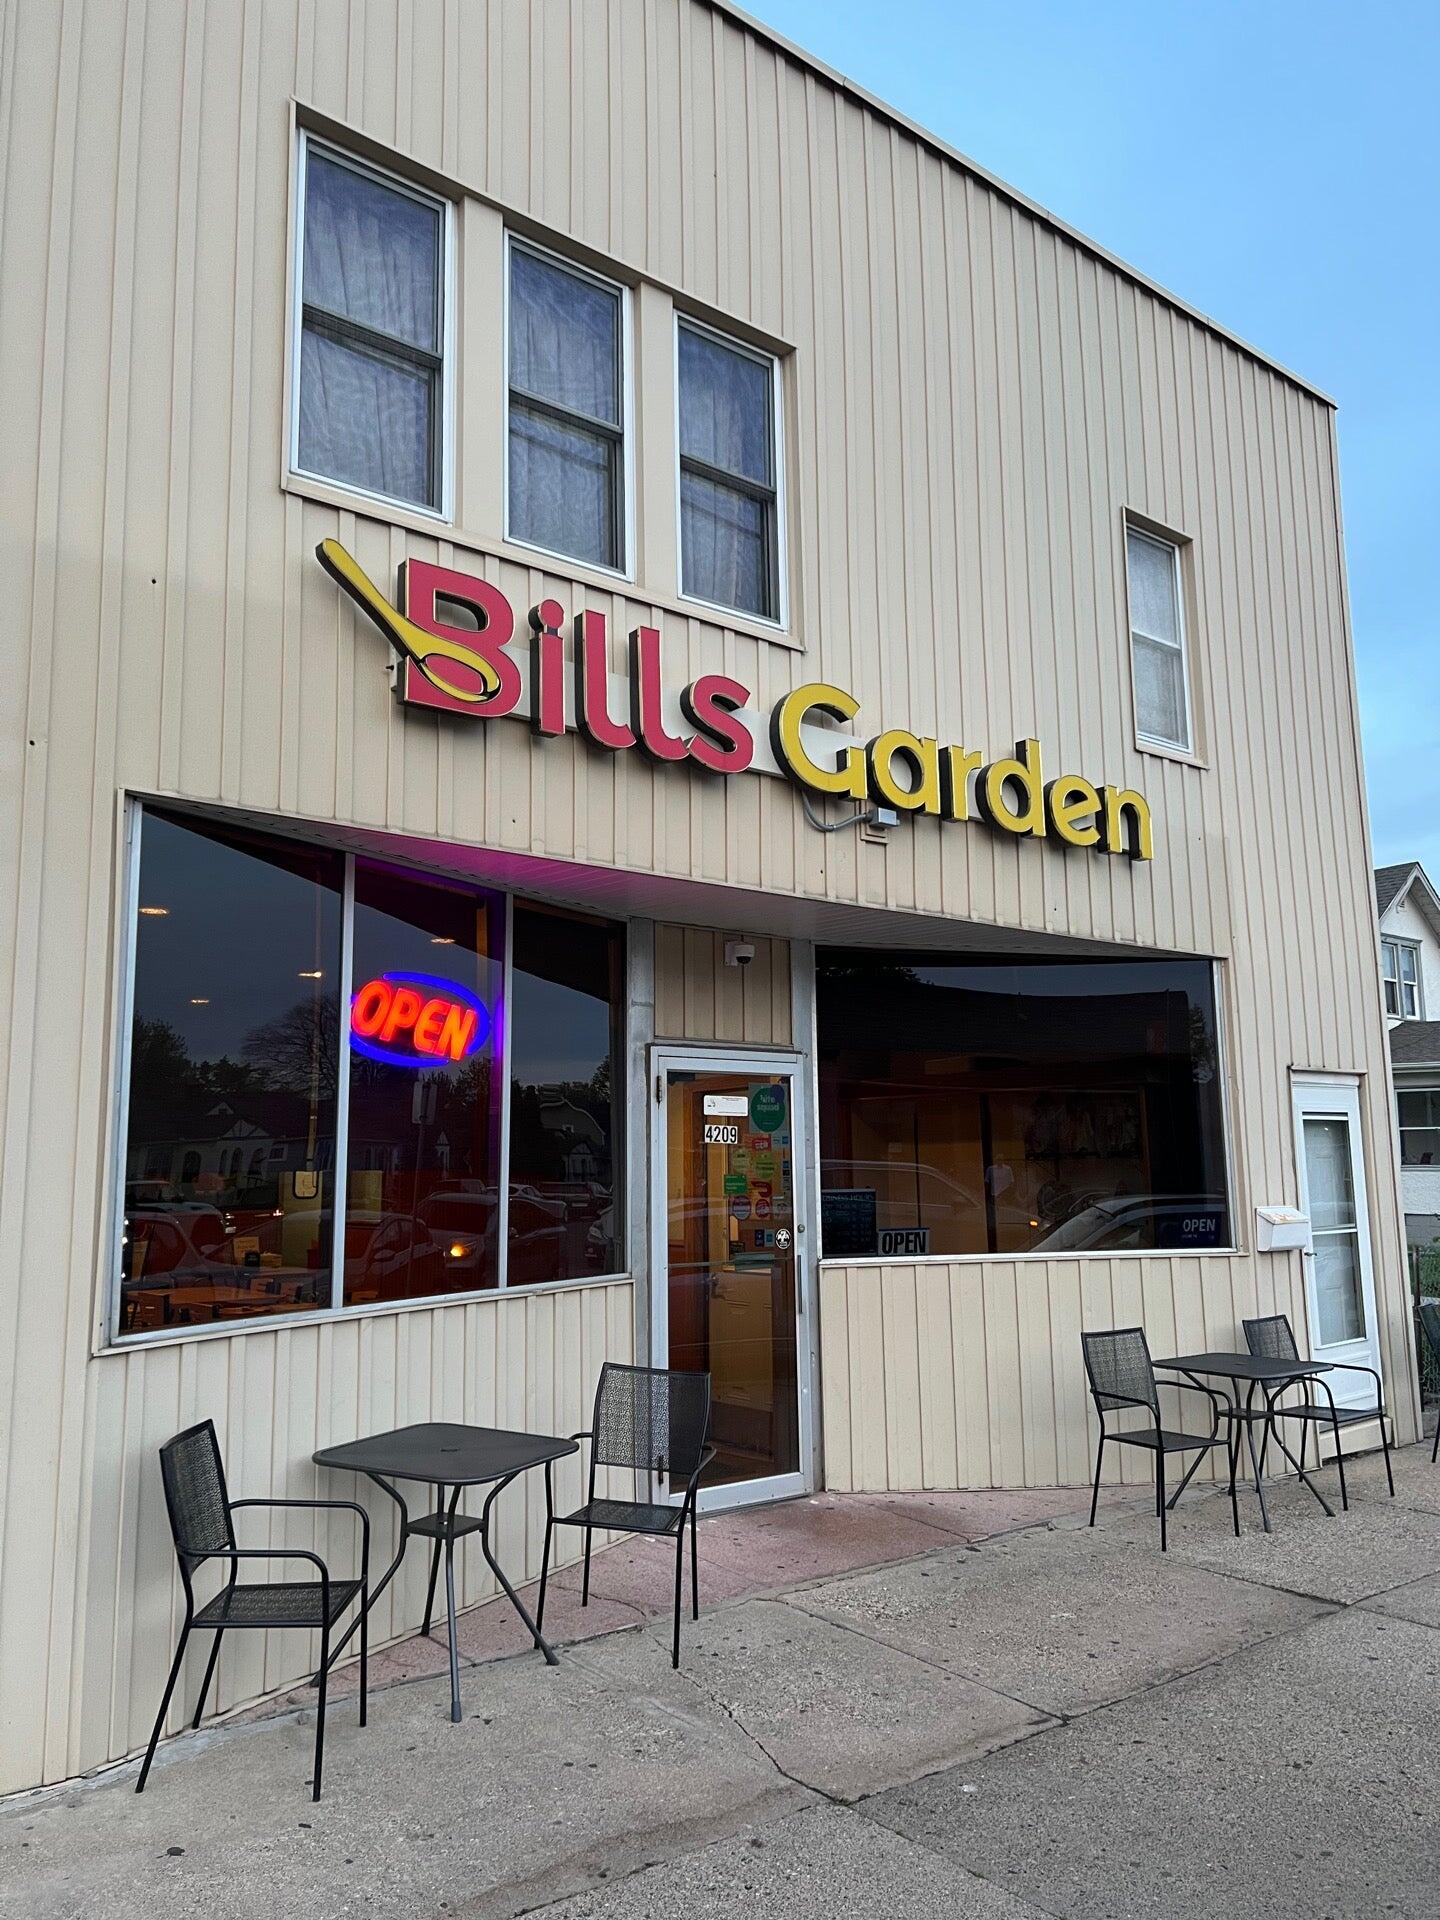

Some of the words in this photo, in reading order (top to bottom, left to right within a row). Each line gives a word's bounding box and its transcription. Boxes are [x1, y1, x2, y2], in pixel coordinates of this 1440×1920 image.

[399, 558, 754, 774] Bills
[770, 683, 1154, 861] Garden
[352, 979, 478, 1061] OPEN
[705, 1125, 737, 1144] 4209
[1183, 1219, 1215, 1232] OPEN
[881, 1231, 927, 1255] OPEN
